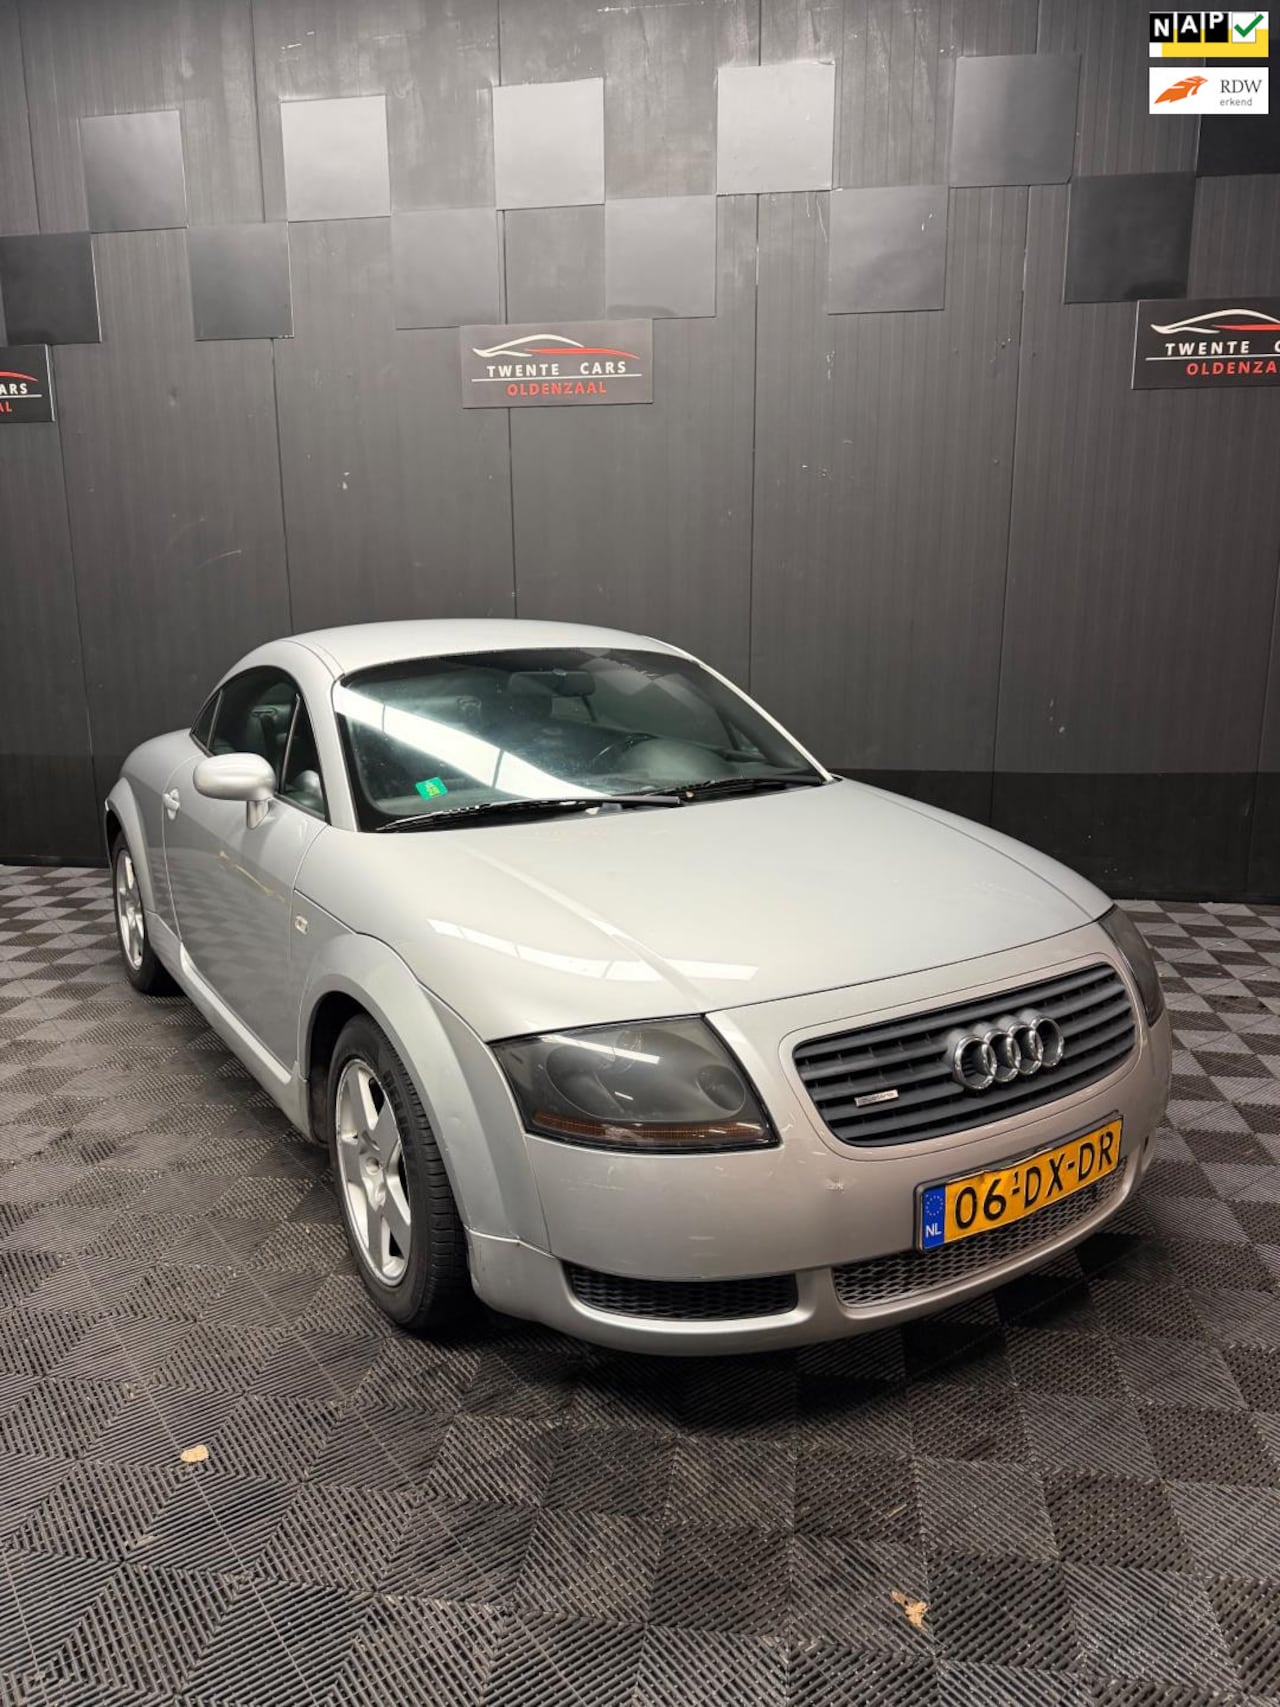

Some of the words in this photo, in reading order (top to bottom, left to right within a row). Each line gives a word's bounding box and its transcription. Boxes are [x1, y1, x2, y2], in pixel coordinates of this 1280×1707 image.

[1165, 341, 1250, 355] TWENTE
[487, 363, 559, 377] TWENTE
[580, 361, 626, 374] CARS
[1186, 361, 1277, 375] OLDENZA
[507, 382, 606, 396] OLDENZAAL
[955, 1131, 1114, 1229] 06-DX-DR
[925, 1223, 941, 1238] NL
